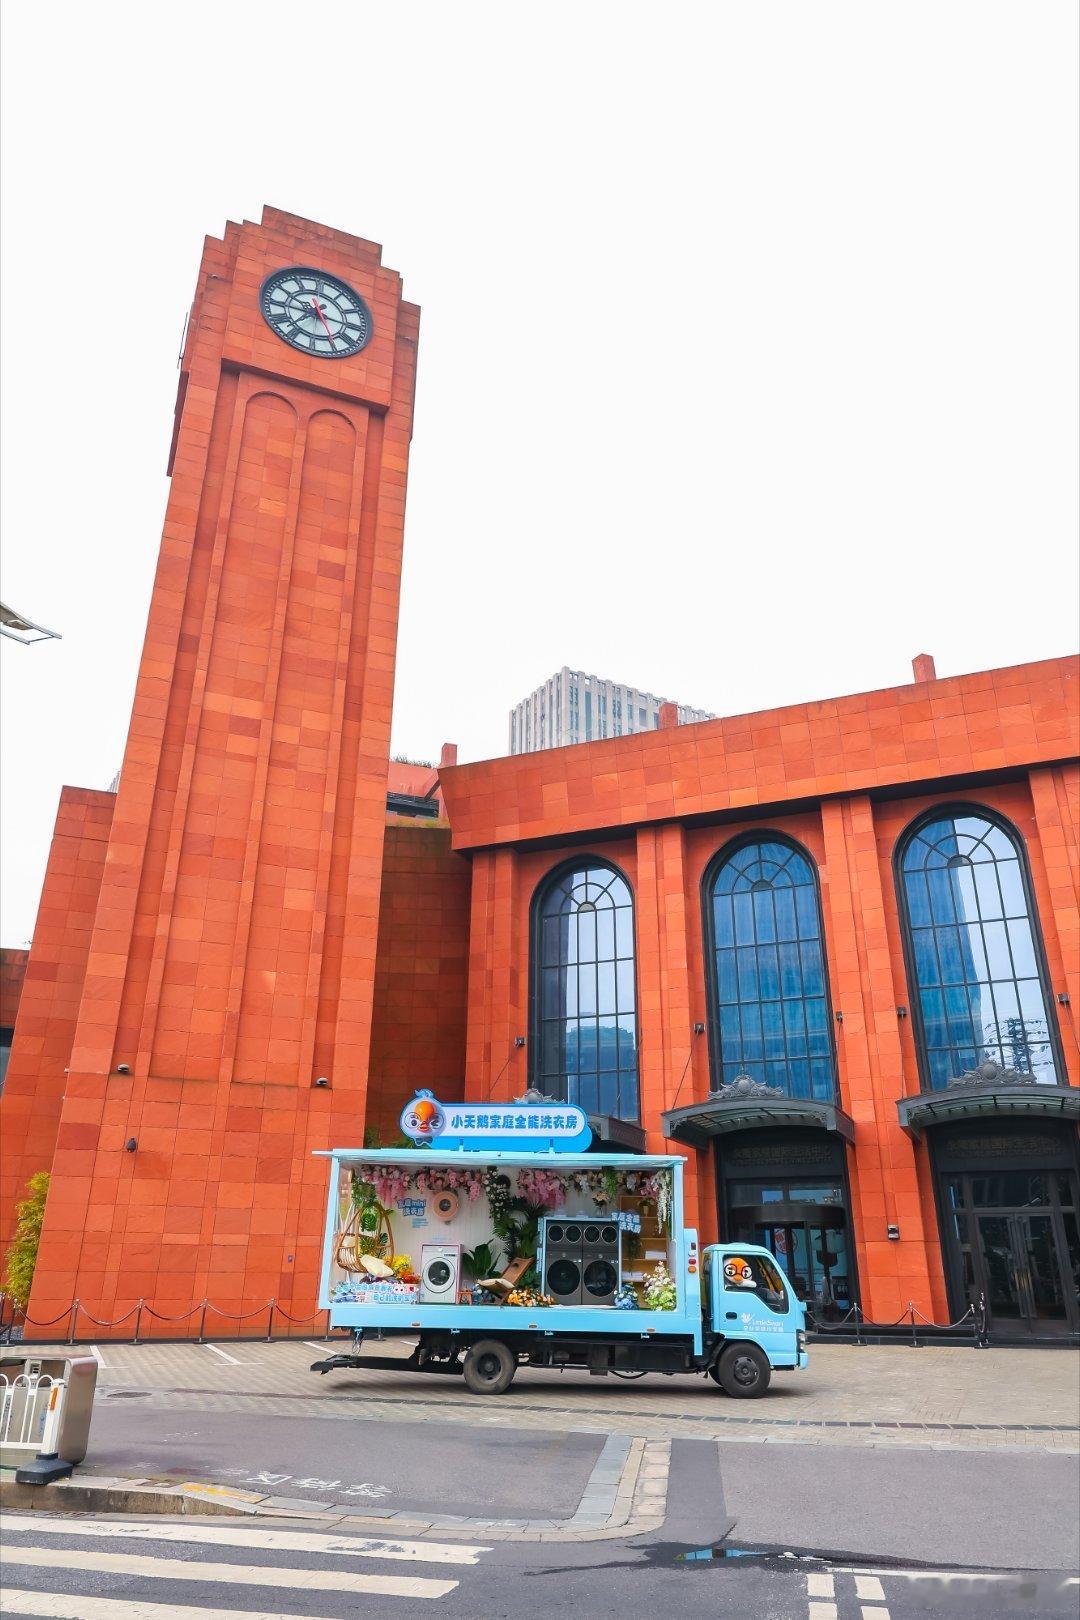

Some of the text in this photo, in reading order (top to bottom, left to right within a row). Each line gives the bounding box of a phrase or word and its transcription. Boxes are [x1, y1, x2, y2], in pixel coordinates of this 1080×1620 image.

[451, 1114, 578, 1130] 小天鹅家庭全能洗衣房
